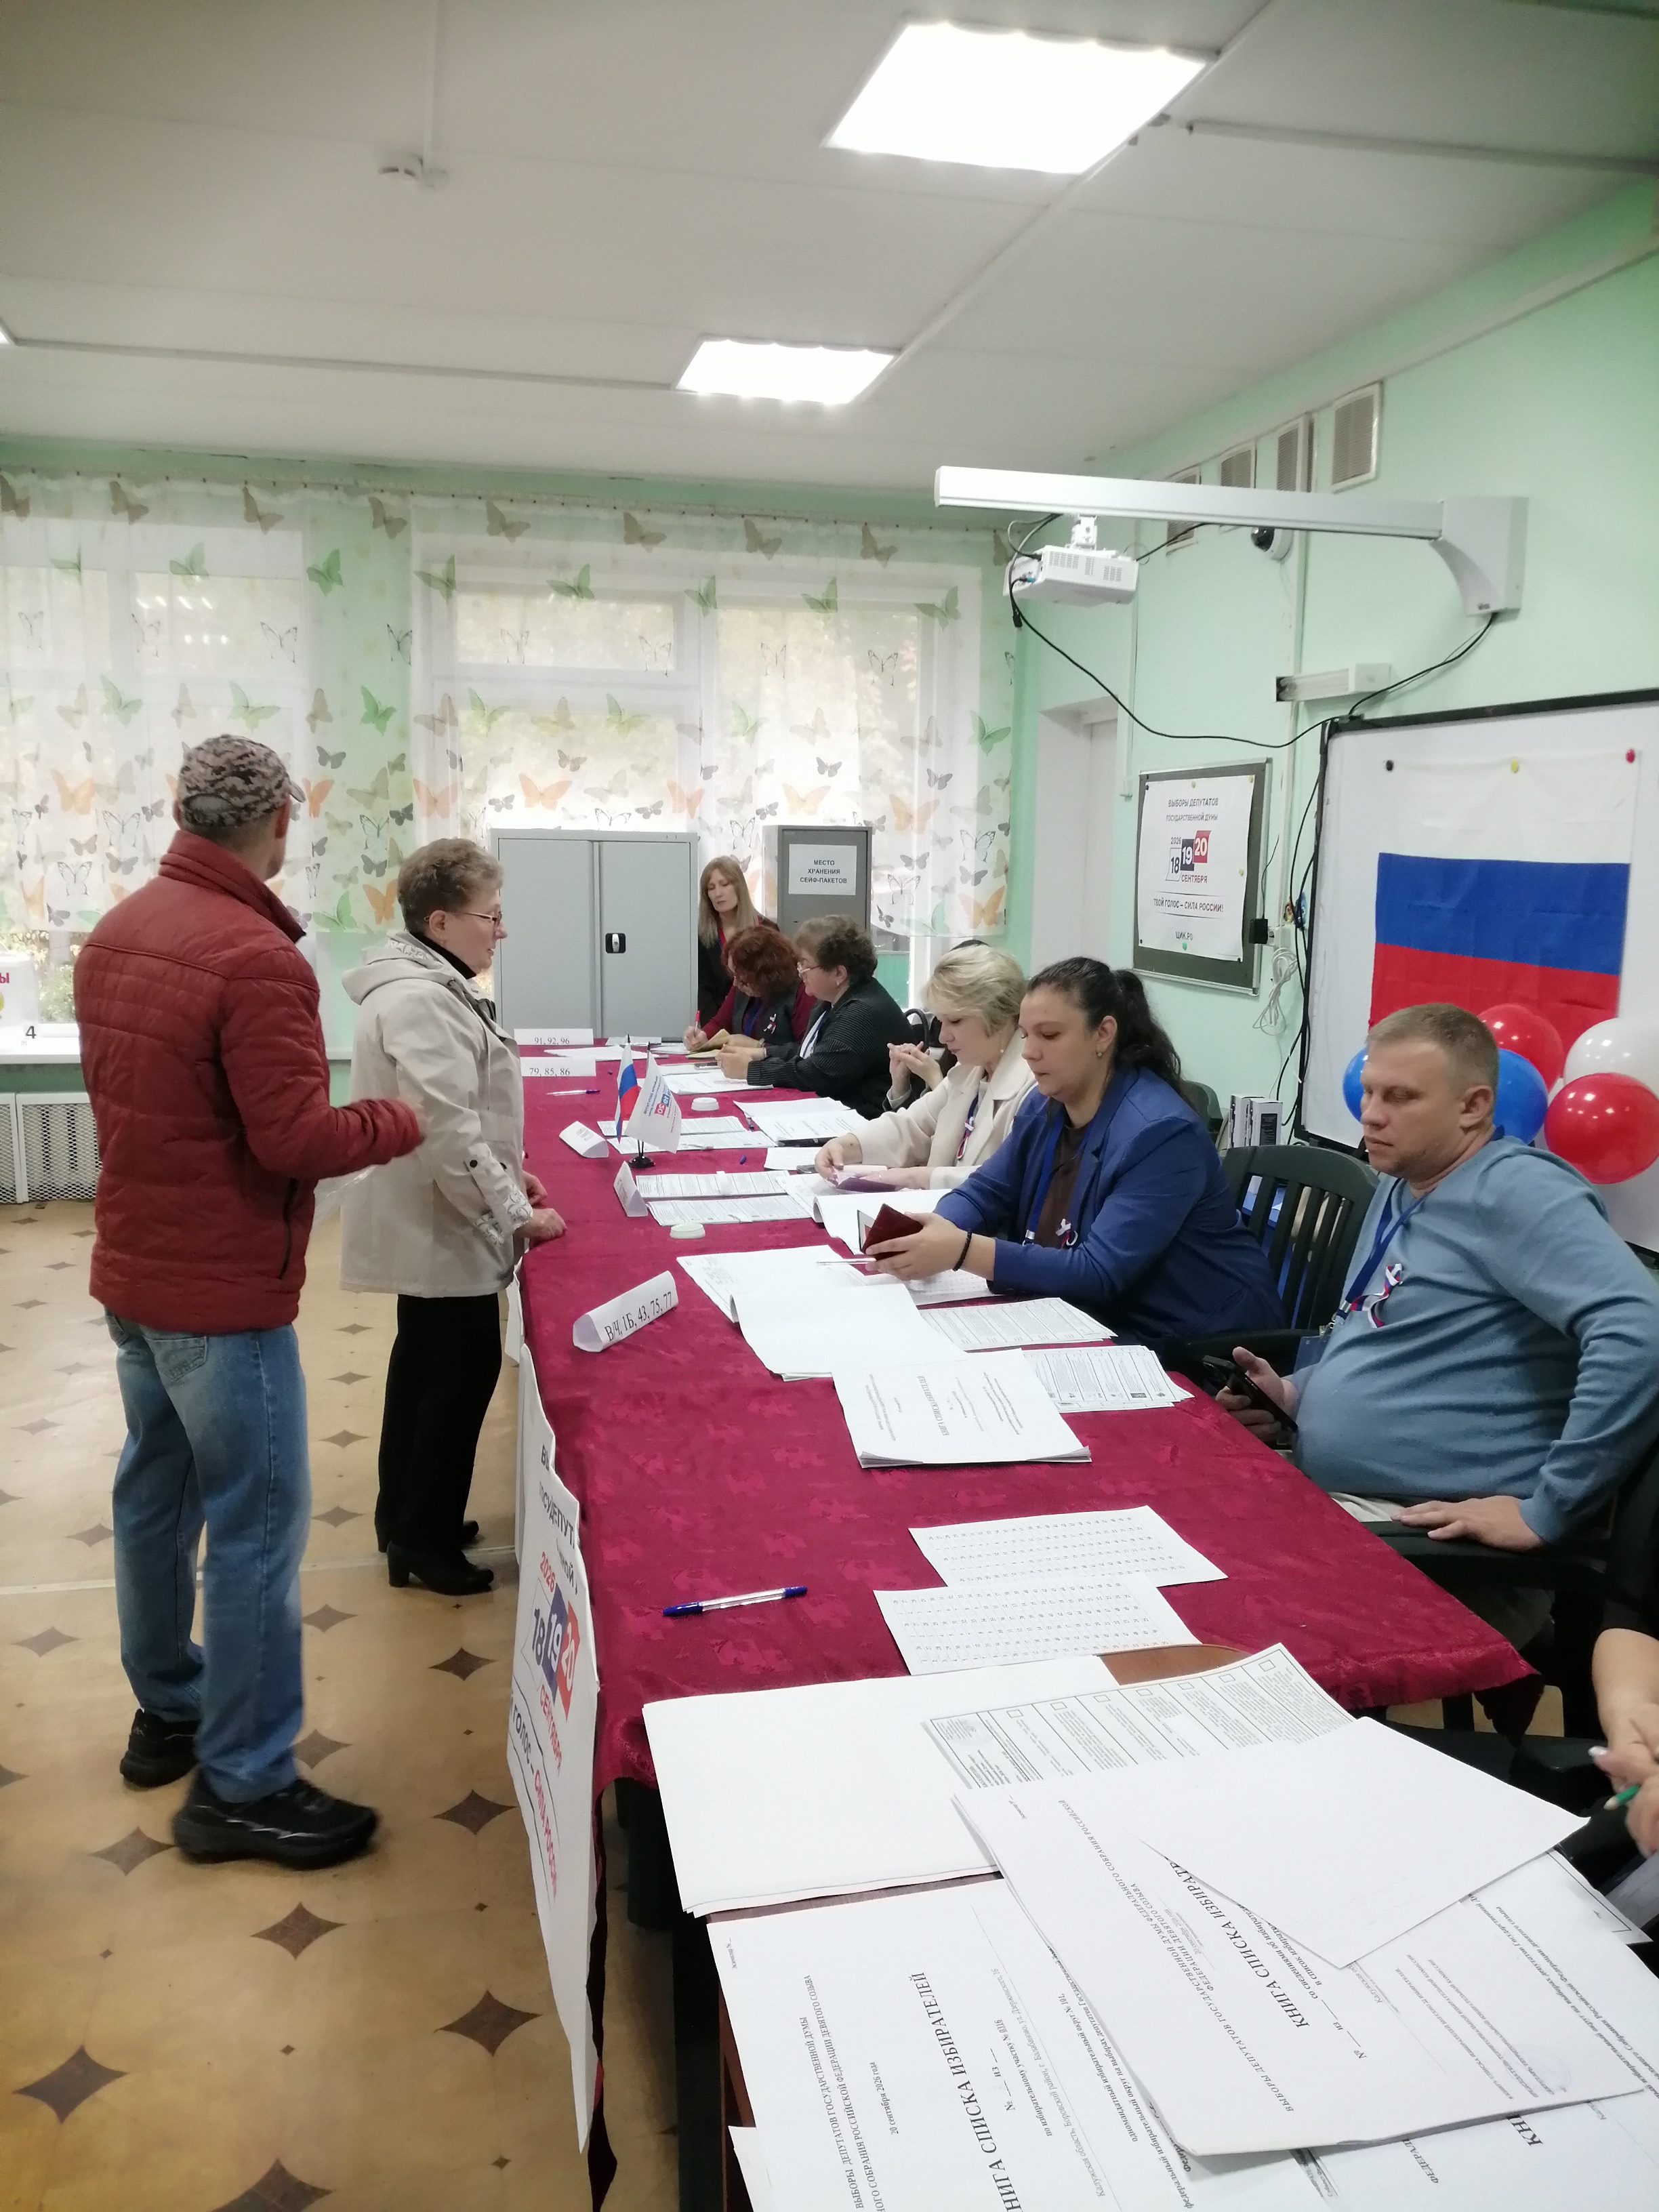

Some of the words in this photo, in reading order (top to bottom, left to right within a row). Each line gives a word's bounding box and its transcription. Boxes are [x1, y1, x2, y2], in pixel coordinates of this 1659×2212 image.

[1166, 813, 1204, 821] ГОСУДАРСТВЕННОЙ
[1204, 813, 1218, 821] ДУМЫ
[1168, 798, 1189, 807] ВЫБОРЫ
[1189, 798, 1218, 807] ДЕПУТАТОВ
[1170, 837, 1181, 845] 2026
[1171, 857, 1180, 874] 18
[1182, 846, 1193, 865] 19
[1194, 838, 1207, 856] 20
[1181, 875, 1208, 883] СЕНТЯБРЯ
[1153, 898, 1164, 907] ТВОЙ
[1164, 900, 1180, 908] ГОЛОС
[1184, 902, 1198, 910] СИЛА
[1199, 903, 1223, 912] РОССИИ!
[26, 1025, 37, 1039] 4
[534, 1037, 547, 1046] 91,
[548, 1037, 559, 1046] 92,
[560, 1037, 569, 1045] 96
[529, 1067, 543, 1076] 79,
[544, 1067, 557, 1076] 85,
[558, 1067, 570, 1076] 86
[604, 1319, 623, 1342] В/Ч,
[622, 1313, 638, 1331] 1Б,
[638, 1305, 650, 1322] 43,
[651, 1298, 663, 1315] 75,
[663, 1291, 672, 1309] 77
[539, 1551, 556, 1593] 2026
[532, 1608, 545, 1666] 18
[548, 1613, 563, 1673] 19
[560, 1622, 575, 1692] 20
[512, 1704, 532, 1764] ГОЛОС
[534, 1769, 546, 1823] СИЛА
[1084, 1831, 1113, 1869] СОБРАНИЯ
[1130, 1883, 1153, 1909] СОЗЫВА
[1149, 1909, 1183, 1944] ДЕВЯТОГО
[1149, 1923, 1172, 1944] ДУМЫ
[1221, 1920, 1269, 1978] СПИСКА
[1266, 1941, 1278, 1949] об
[1166, 1946, 1226, 2022] ГОСУДАРСТВЕННОЙ
[1176, 1944, 1214, 1991] ФЕДЕРАЦИИ
[1275, 1949, 1311, 1990] сведениями
[1294, 1955, 1317, 1980] список
[803, 1974, 818, 2001] СОЗЫВА
[1057, 1992, 1069, 2005] 101,
[1265, 1980, 1310, 2028] КНИГА
[1308, 1990, 1318, 1999] со
[798, 2016, 814, 2039] ДУМЫ
[811, 2001, 832, 2038] ДЕВЯТОГО
[908, 1971, 966, 2076] ИЗБИРАТЕЛЕЙ
[993, 2018, 1008, 2033] 0316
[1068, 2013, 1082, 2031] округ
[1332, 2021, 1343, 2030] из
[823, 2038, 844, 2083] ФЕДЕРАЦИИ
[1006, 2041, 1025, 2068] участку
[1076, 2031, 1109, 2083] избирательный
[1099, 2037, 1118, 2066] выборах
[1223, 2024, 1265, 2072] ДЕПУТАТОВ
[806, 2039, 836, 2116] ГОСУДАРСТВЕННОЙ
[869, 2061, 879, 2075] года
[872, 2075, 884, 2092] 2026
[991, 2066, 1001, 2077] из
[1114, 2066, 1123, 2076] на
[1017, 2069, 1048, 2127] избирательному
[1119, 2077, 1134, 2097] округ
[1260, 2074, 1294, 2112] ВЫБОРЫ
[838, 2083, 863, 2140] РОССИЙСКОЙ
[880, 2092, 896, 2125] сентября
[957, 2079, 997, 2153] СПИСКА
[1004, 2100, 1015, 2111] №
[1048, 2091, 1072, 2127] Боровский
[1103, 2084, 1138, 2142] одномандатный
[829, 2116, 853, 2165] ДЕПУТАТОВ
[888, 2126, 899, 2135] 20
[1044, 2127, 1052, 2136] по
[1128, 2098, 1164, 2154] избирательный
[855, 2141, 877, 2188] СОБРАНИЯ
[1081, 2157, 1106, 2197] Калужская
[844, 2168, 864, 2209] ВЫБОРЫ
[1158, 2155, 1194, 2209] федеральный
